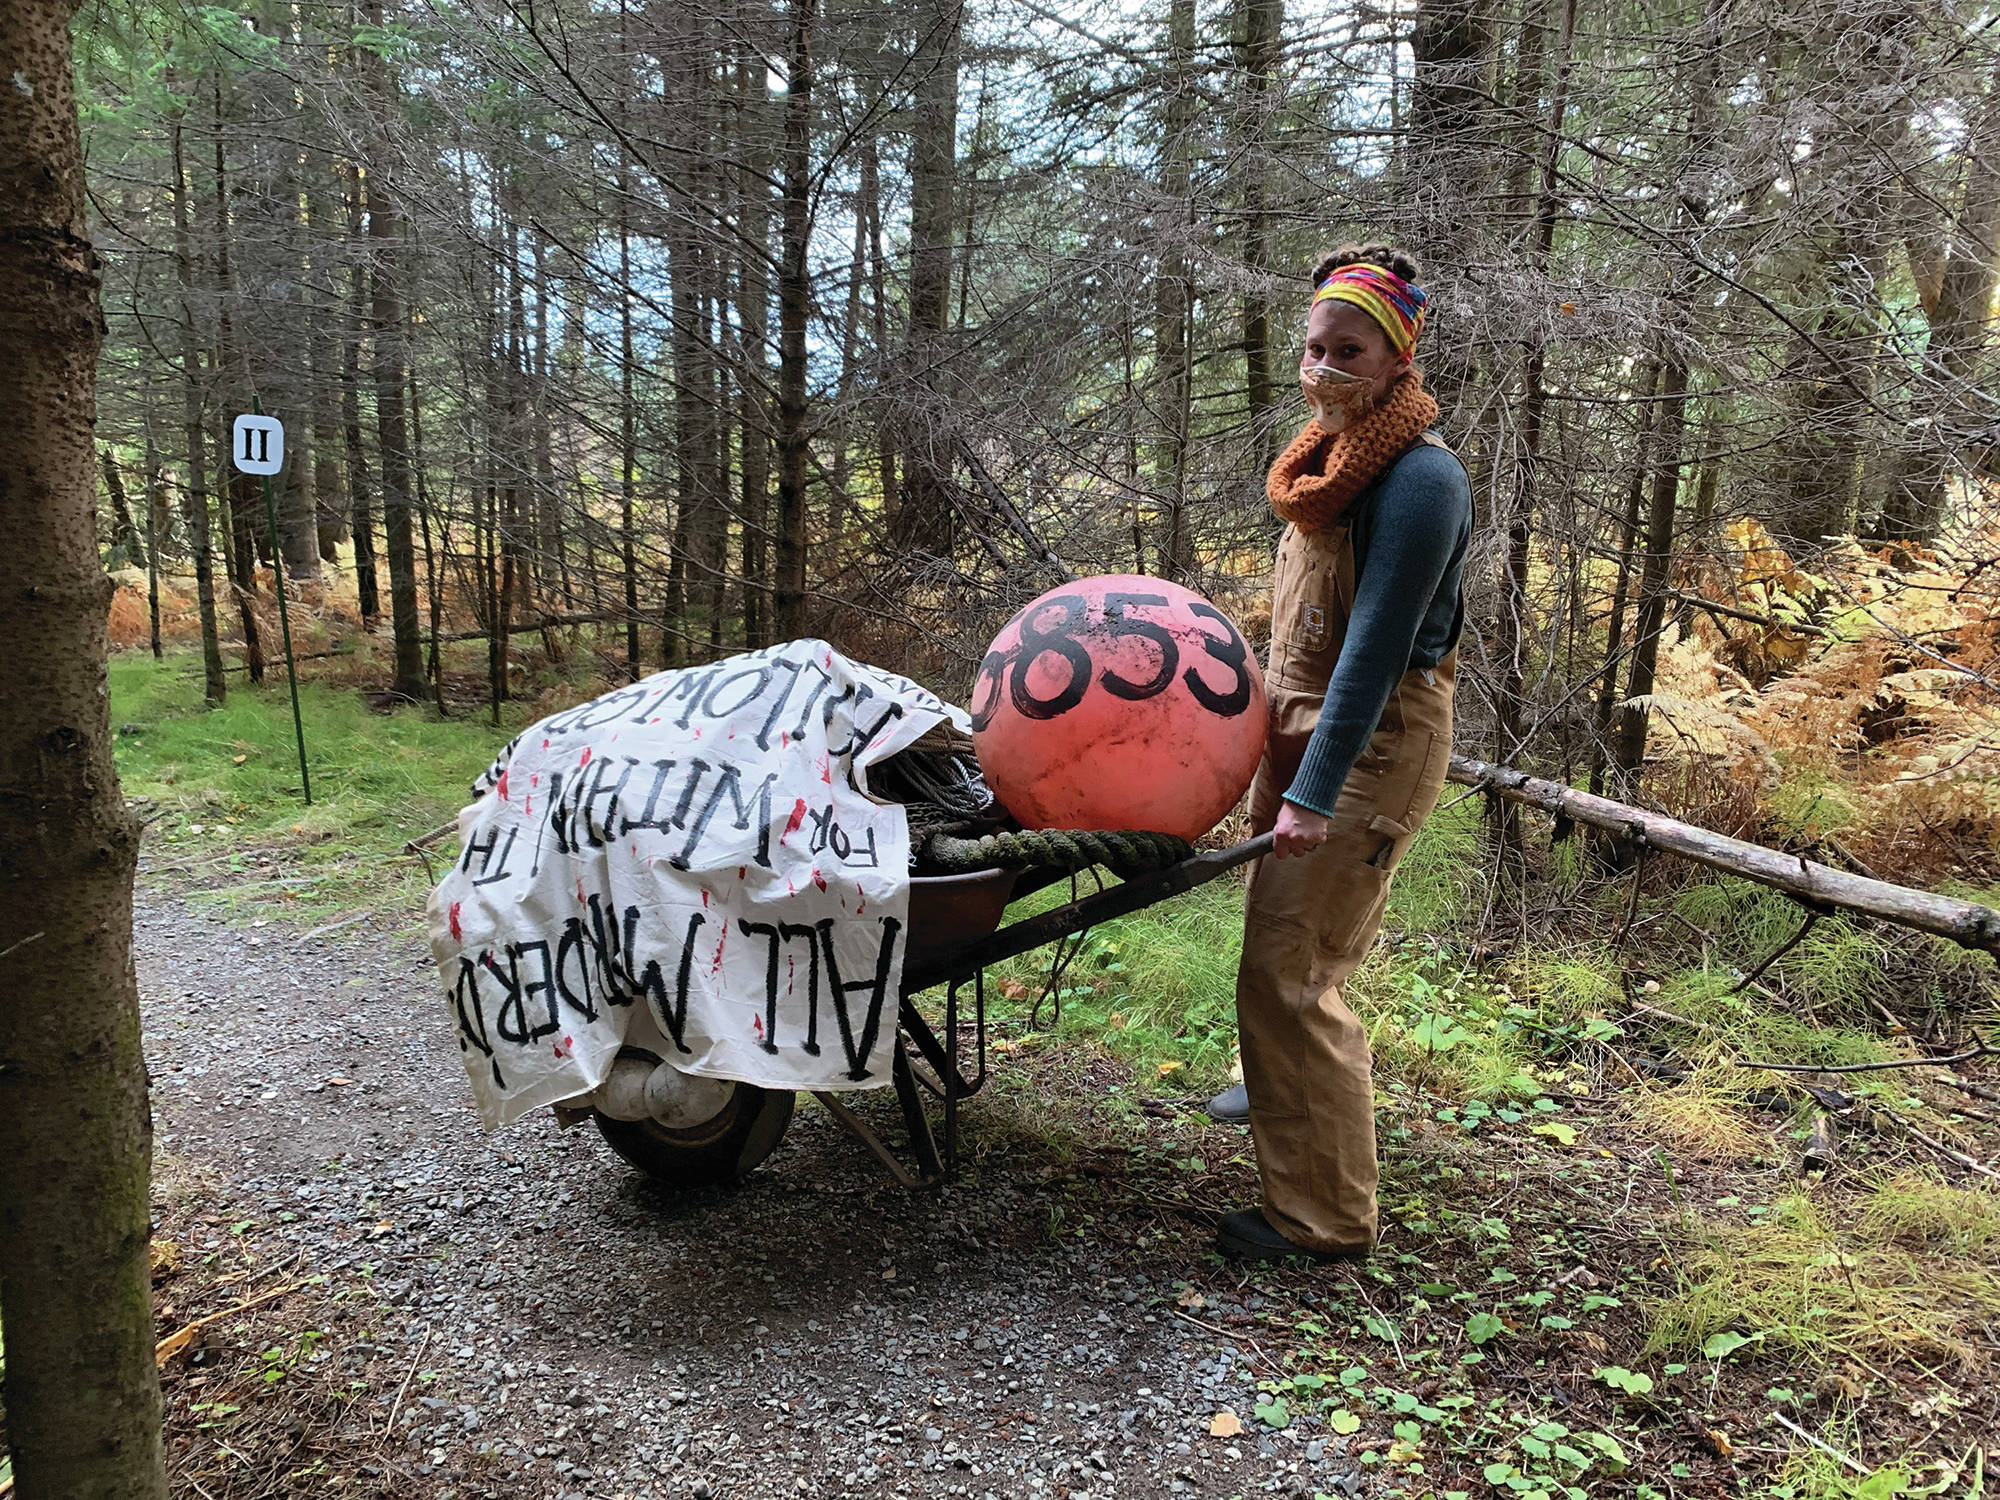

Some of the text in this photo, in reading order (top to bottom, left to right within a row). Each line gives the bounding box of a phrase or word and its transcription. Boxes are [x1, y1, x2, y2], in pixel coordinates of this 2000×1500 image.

[240, 427, 272, 462] II
[530, 754, 779, 873] WITHIN
[809, 804, 879, 868] FOR
[462, 823, 520, 887] TH
[738, 915, 902, 1082] ALL
